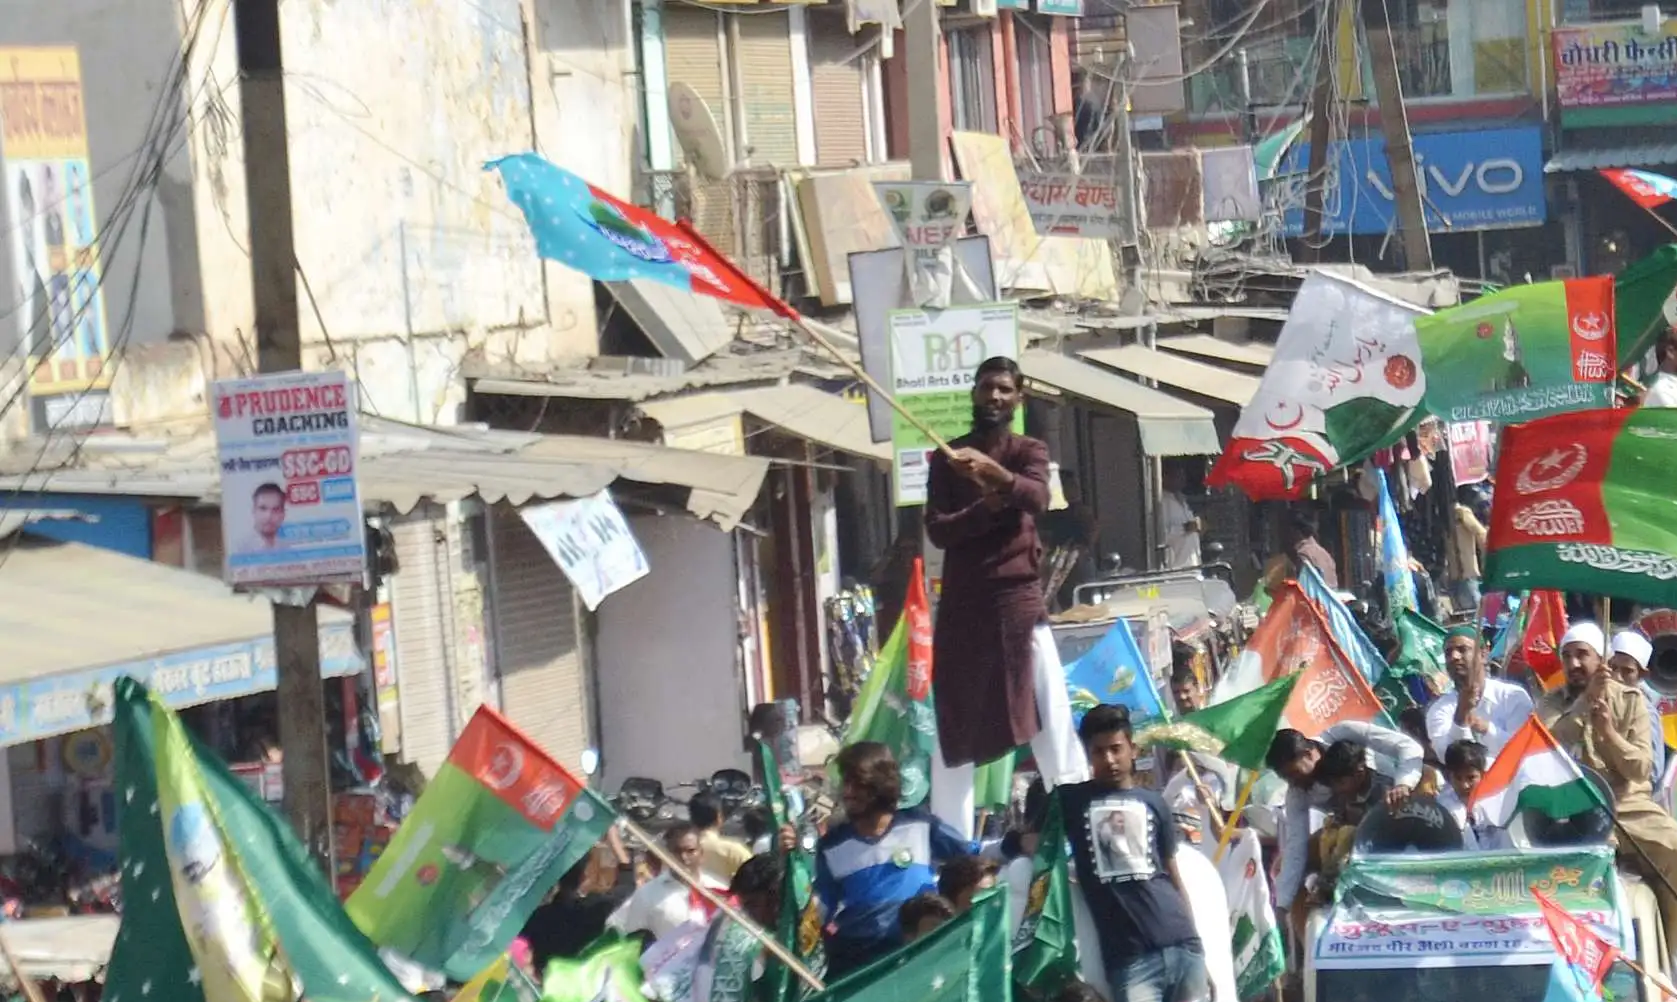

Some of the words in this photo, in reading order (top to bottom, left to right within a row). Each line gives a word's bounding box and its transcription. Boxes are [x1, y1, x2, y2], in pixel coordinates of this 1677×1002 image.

[1452, 207, 1494, 221] MOBILE
[1496, 204, 1538, 219] WORLD
[235, 384, 346, 418] PRUDENCE
[253, 411, 349, 436] COACHING
[283, 449, 351, 478] SSC-GD
